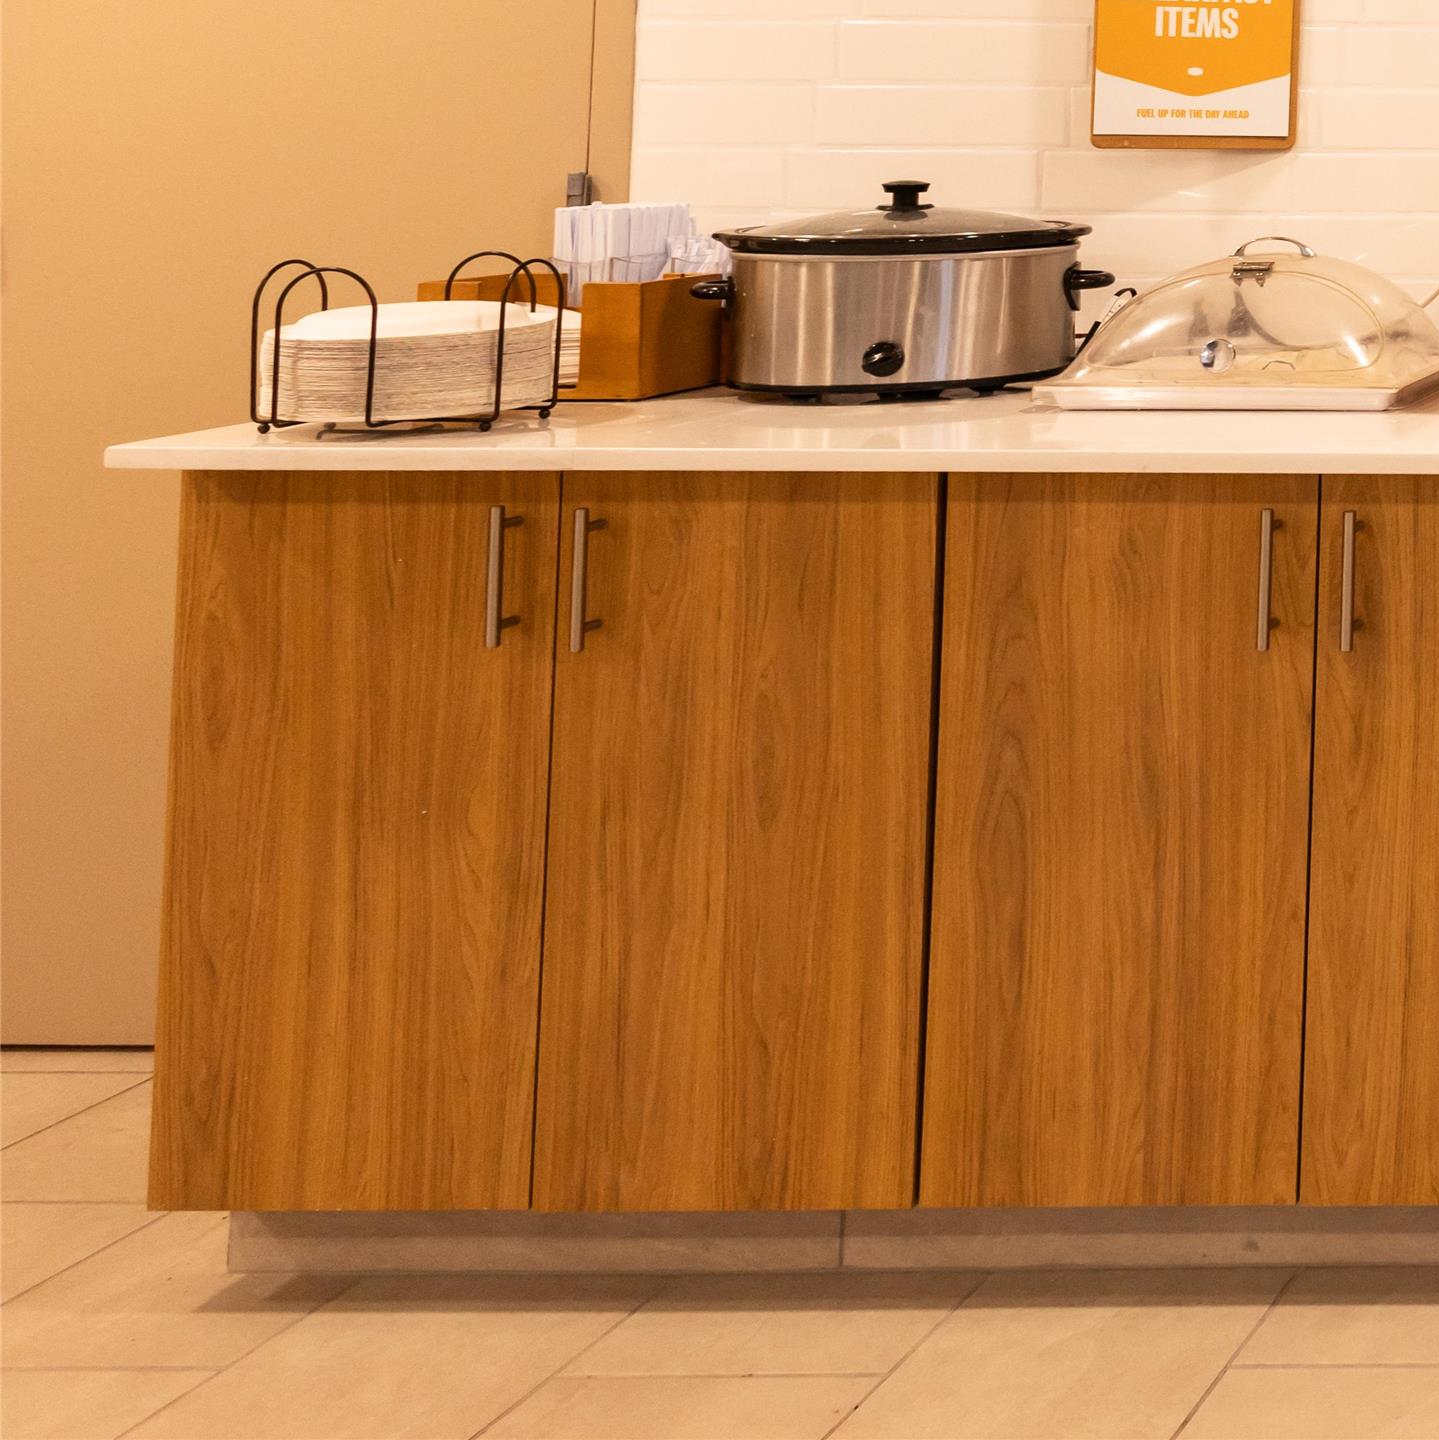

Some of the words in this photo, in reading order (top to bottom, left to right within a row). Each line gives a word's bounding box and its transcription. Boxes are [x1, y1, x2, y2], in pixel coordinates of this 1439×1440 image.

[1154, 6, 1239, 39] ITEMS
[1136, 109, 1155, 118] FUEL
[1158, 109, 1169, 118] UP
[1171, 109, 1186, 118] FOR
[1189, 109, 1203, 118] THE
[1205, 110, 1221, 119] DAY
[1223, 110, 1249, 119] AHEAD
